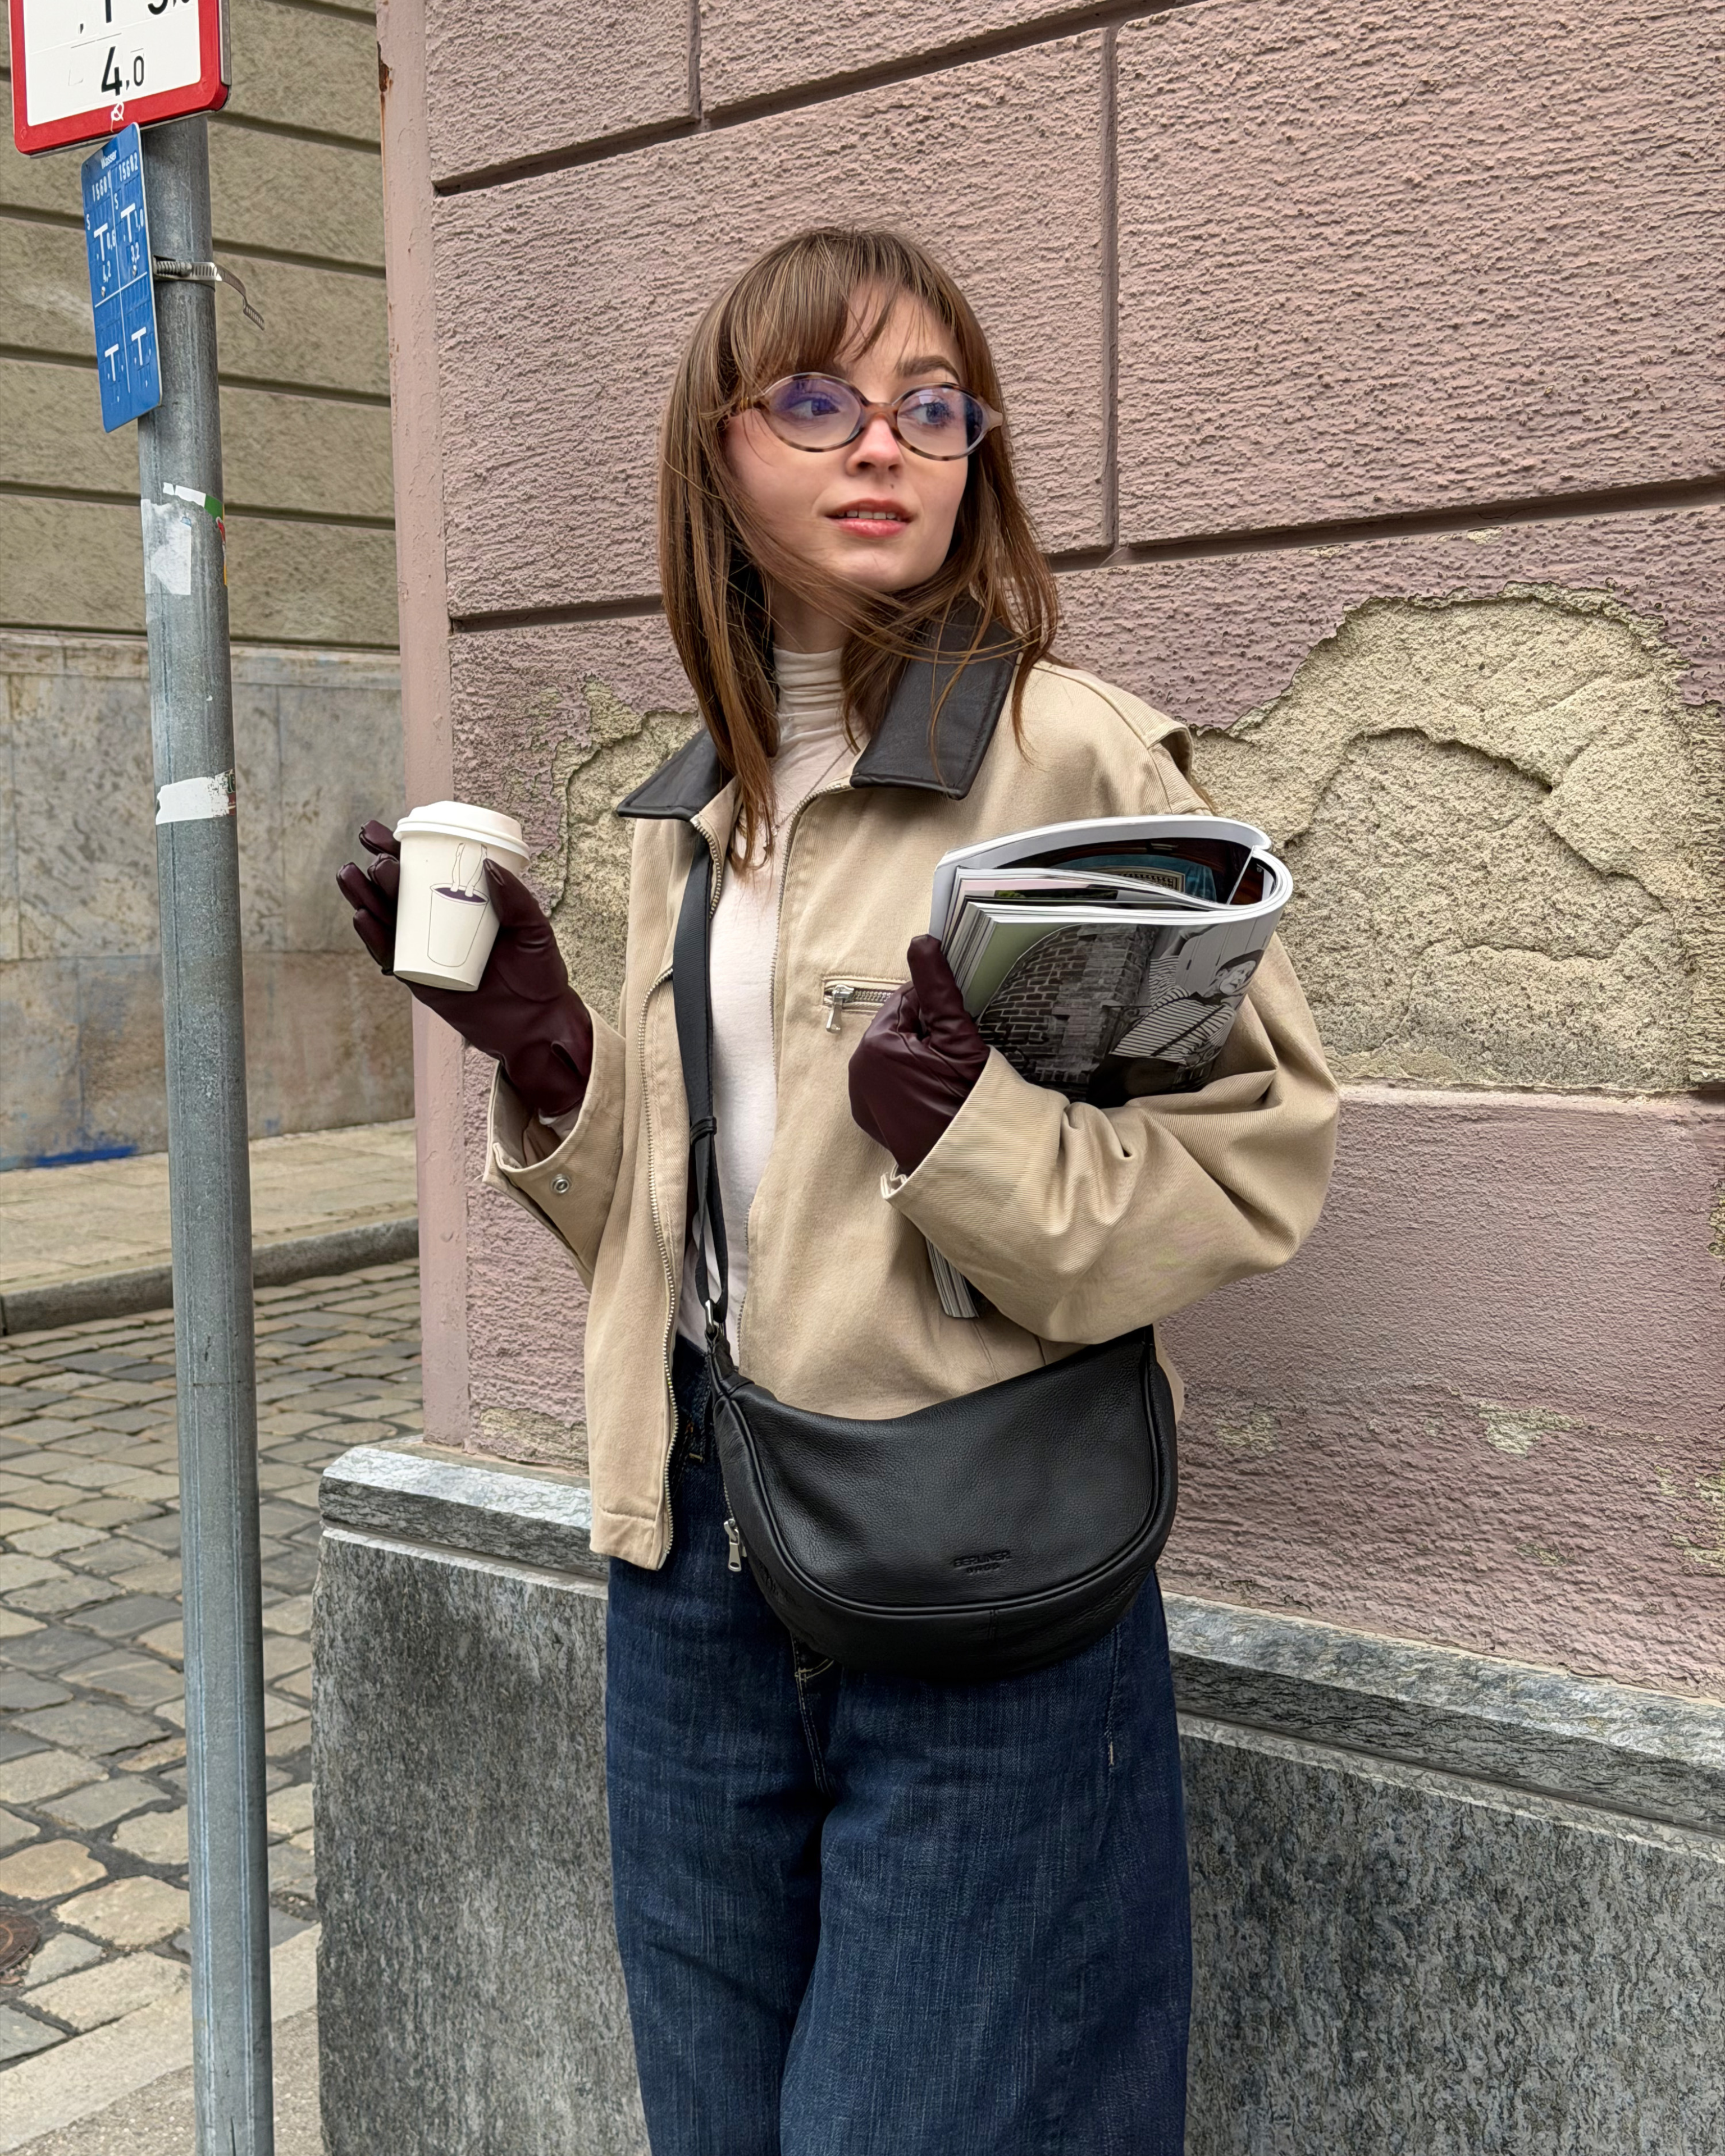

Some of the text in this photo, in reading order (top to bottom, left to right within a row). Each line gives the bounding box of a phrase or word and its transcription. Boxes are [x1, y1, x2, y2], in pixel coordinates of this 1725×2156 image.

[101, 45, 144, 97] 4,0
[118, 152, 138, 182] 15682
[94, 222, 108, 262] T
[120, 203, 136, 243] T
[104, 343, 119, 382] T
[131, 326, 147, 366] T
